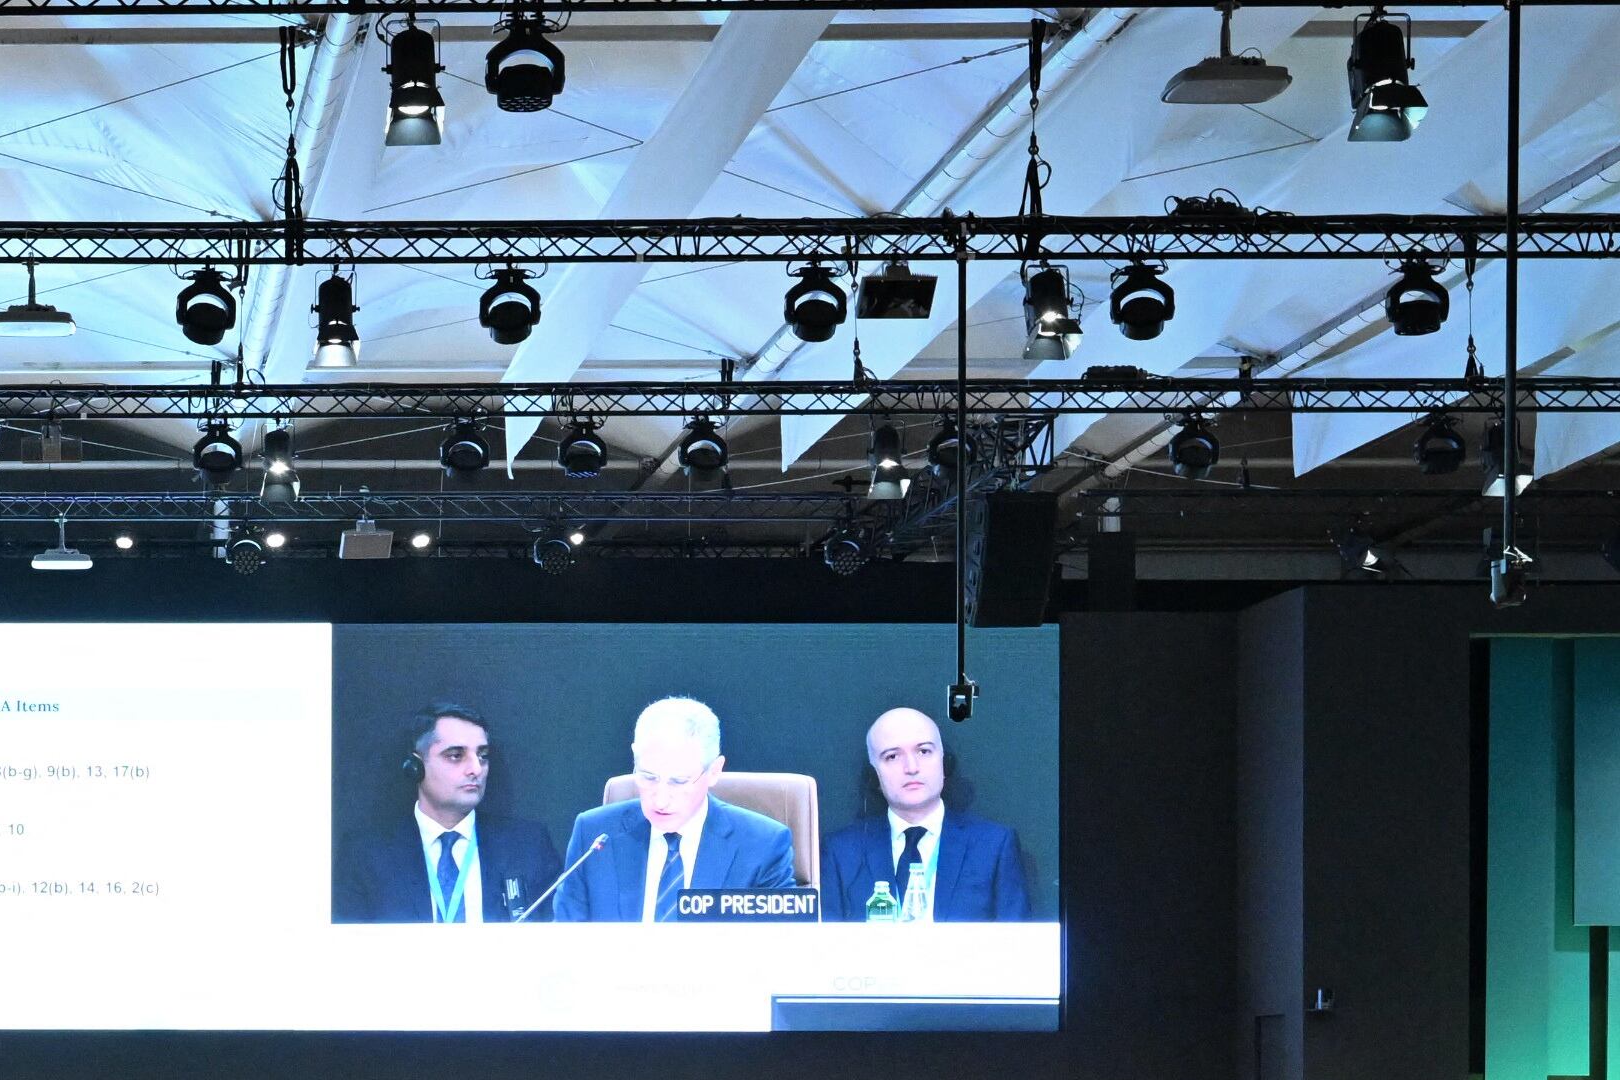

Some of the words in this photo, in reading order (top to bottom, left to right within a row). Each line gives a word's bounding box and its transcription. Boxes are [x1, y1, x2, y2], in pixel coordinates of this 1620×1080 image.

[17, 699, 60, 712] Items
[115, 764, 150, 781] 17(b)
[8, 823, 25, 838] 10
[132, 880, 160, 896] 2(c)
[679, 894, 714, 915] COP
[721, 894, 816, 914] PRESIDENT
